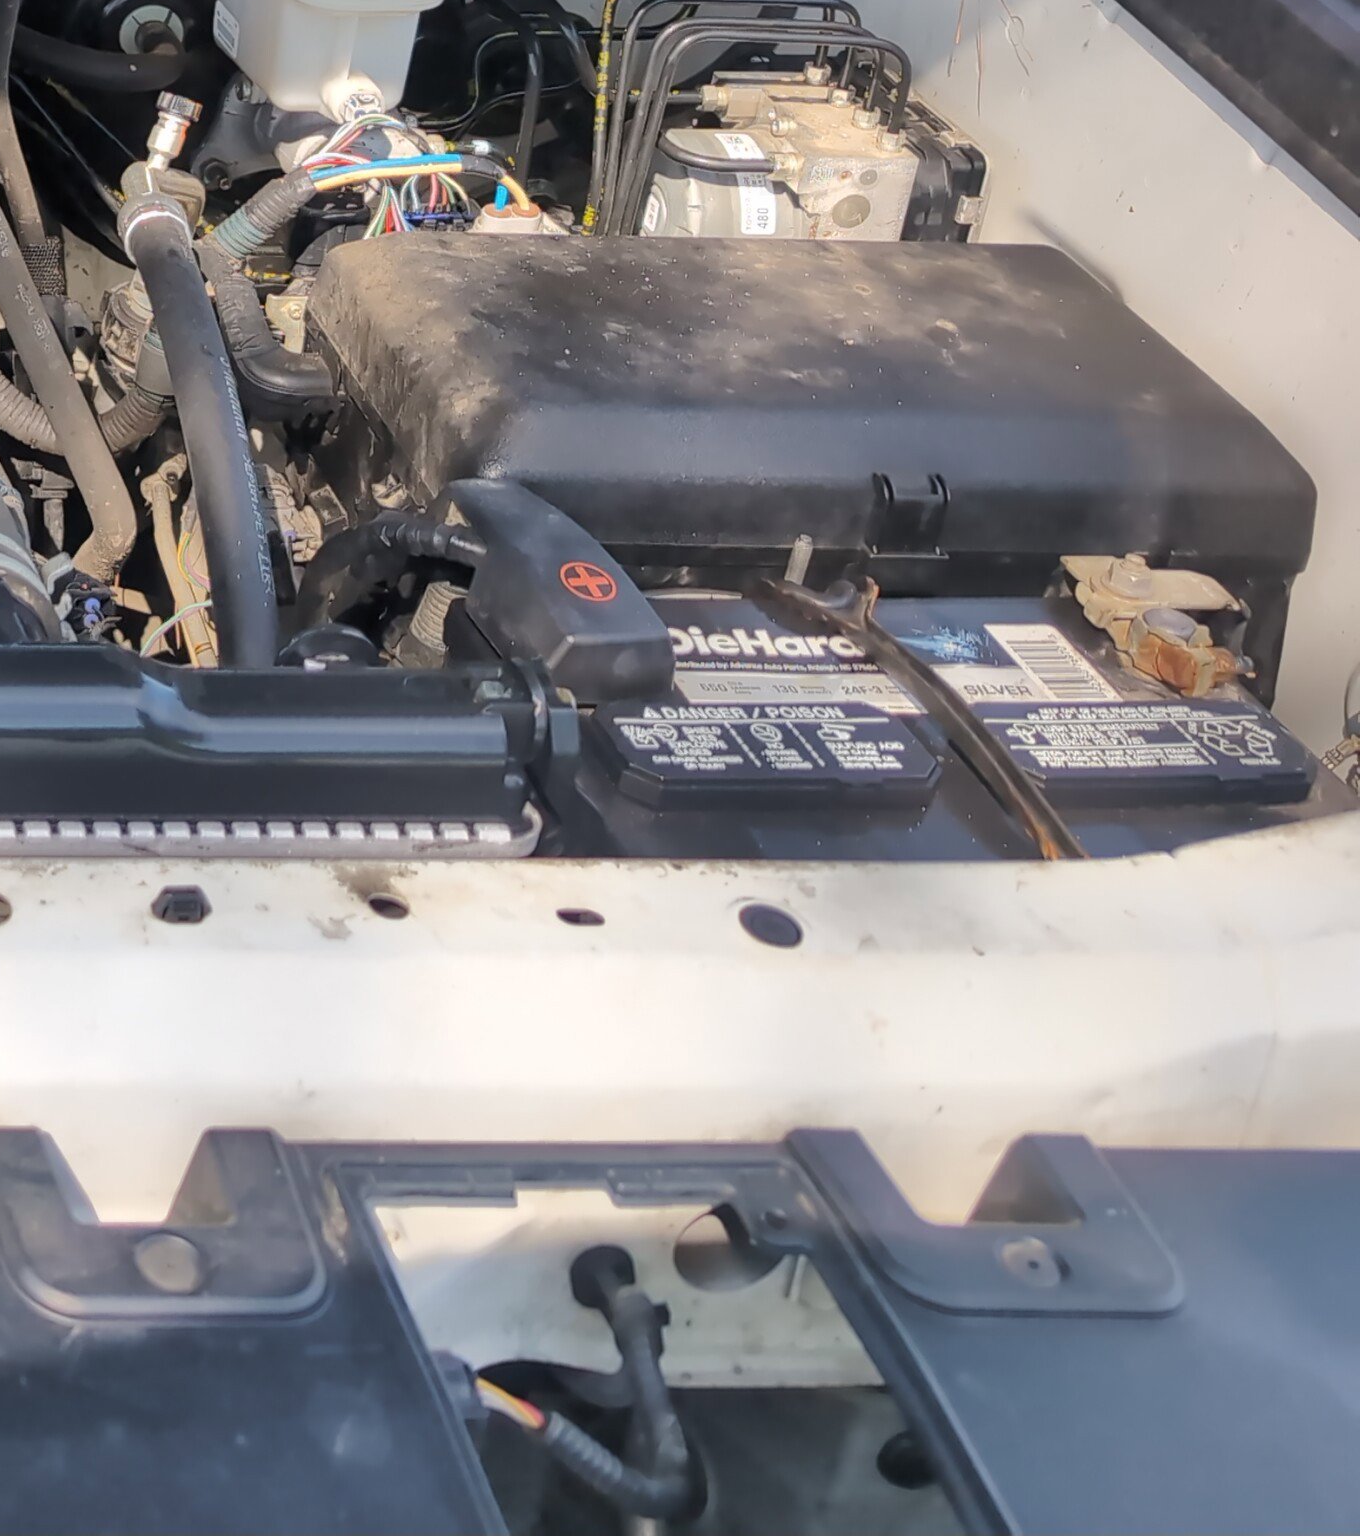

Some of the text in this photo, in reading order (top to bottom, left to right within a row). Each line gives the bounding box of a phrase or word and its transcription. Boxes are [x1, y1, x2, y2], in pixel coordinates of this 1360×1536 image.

[757, 208, 769, 229] 480
[963, 683, 1033, 697] SILVER
[661, 706, 746, 719] DANGER
[764, 706, 846, 719] POISON
